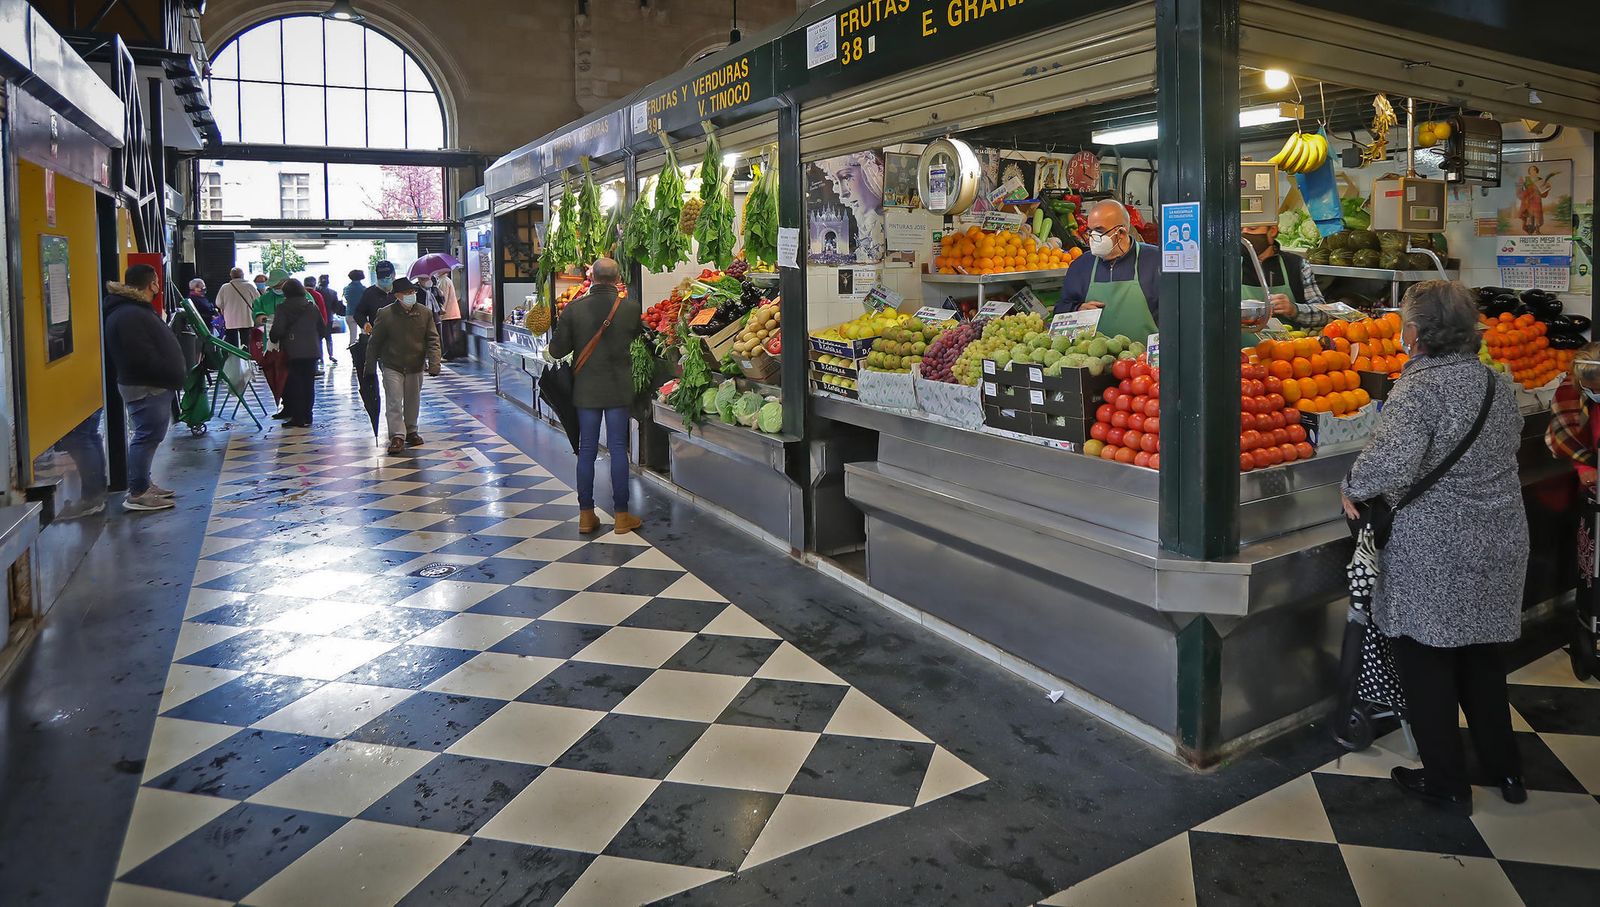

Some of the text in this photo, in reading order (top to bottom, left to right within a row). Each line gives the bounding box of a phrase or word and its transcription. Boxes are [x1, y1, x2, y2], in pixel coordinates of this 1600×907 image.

[922, 9, 938, 37] E.
[841, 37, 863, 65] 38
[647, 57, 749, 115] FRUTAS Y VERDURAS
[698, 81, 751, 117] V. TINOCO
[647, 117, 658, 135] 39
